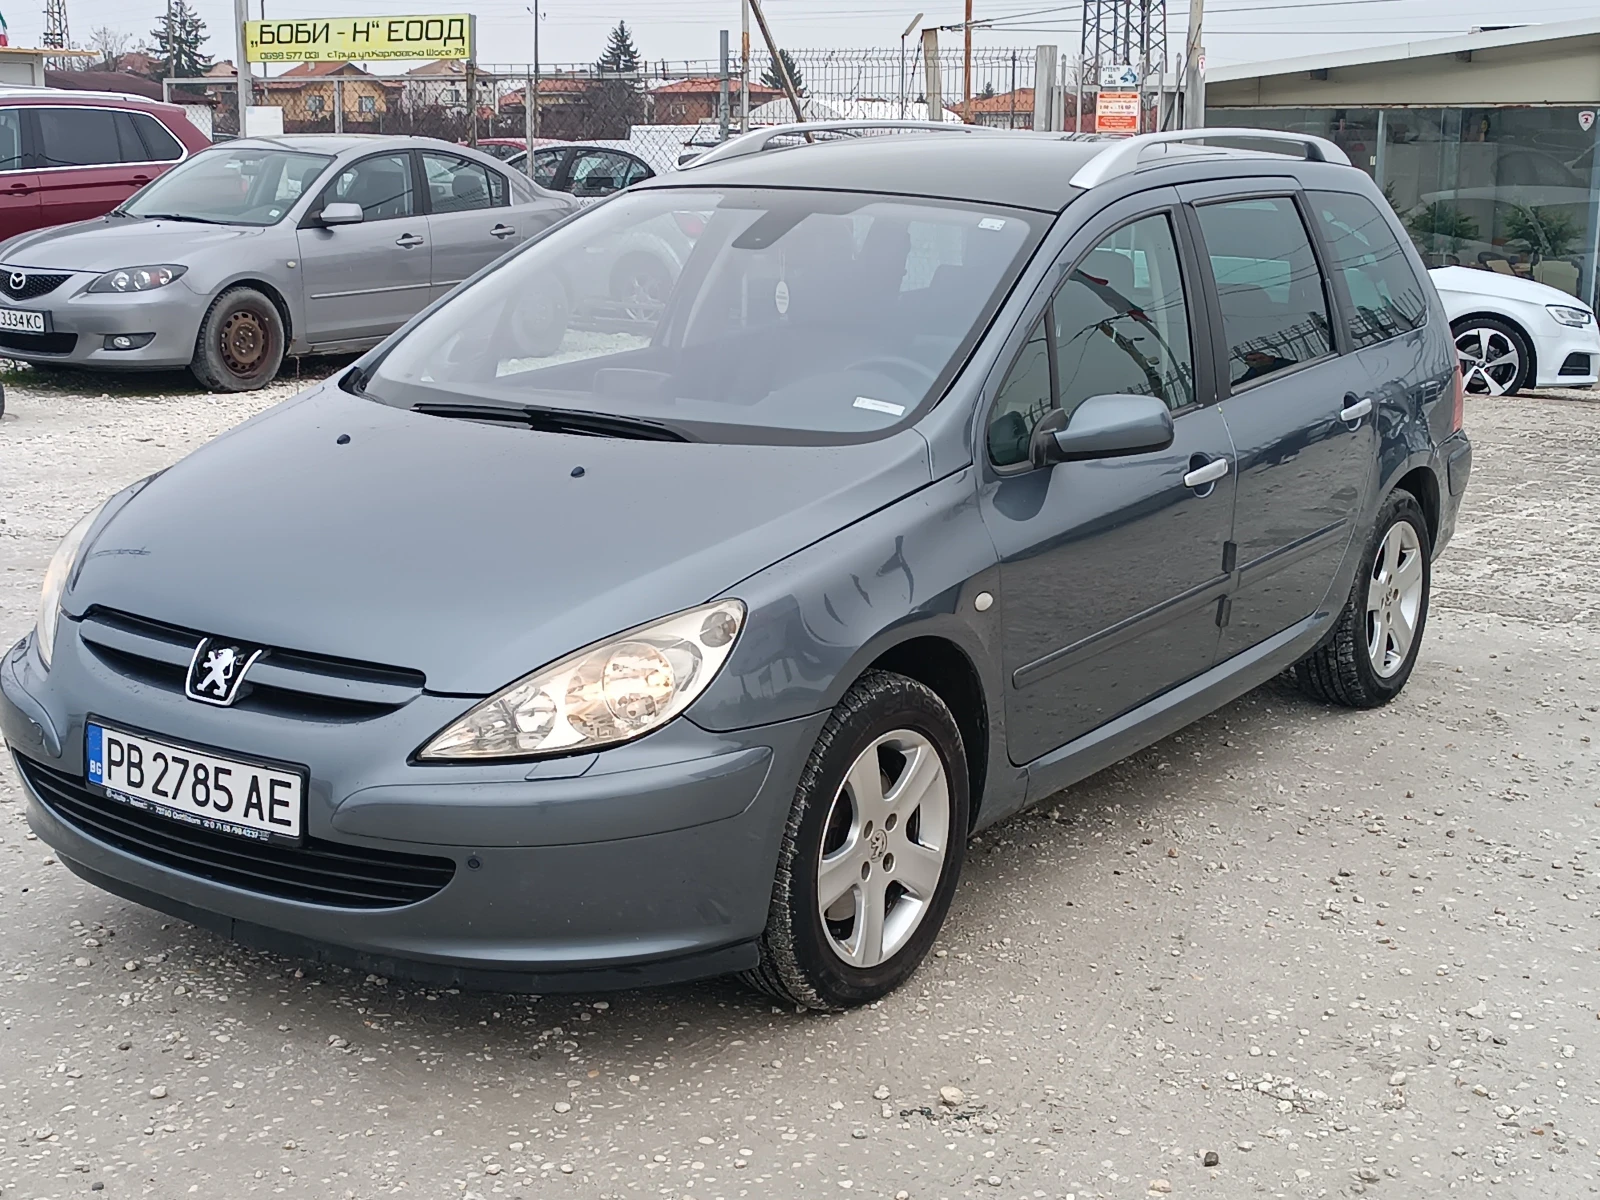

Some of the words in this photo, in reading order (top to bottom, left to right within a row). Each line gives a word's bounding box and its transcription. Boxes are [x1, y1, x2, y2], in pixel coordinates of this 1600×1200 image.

[387, 18, 465, 47] ЕООД
[286, 51, 302, 60] 577
[1, 311, 24, 328] 3334
[26, 314, 42, 329] KC
[90, 760, 102, 776] BG
[107, 737, 145, 789] PB
[151, 751, 234, 812] 2785
[243, 774, 292, 827] AE
